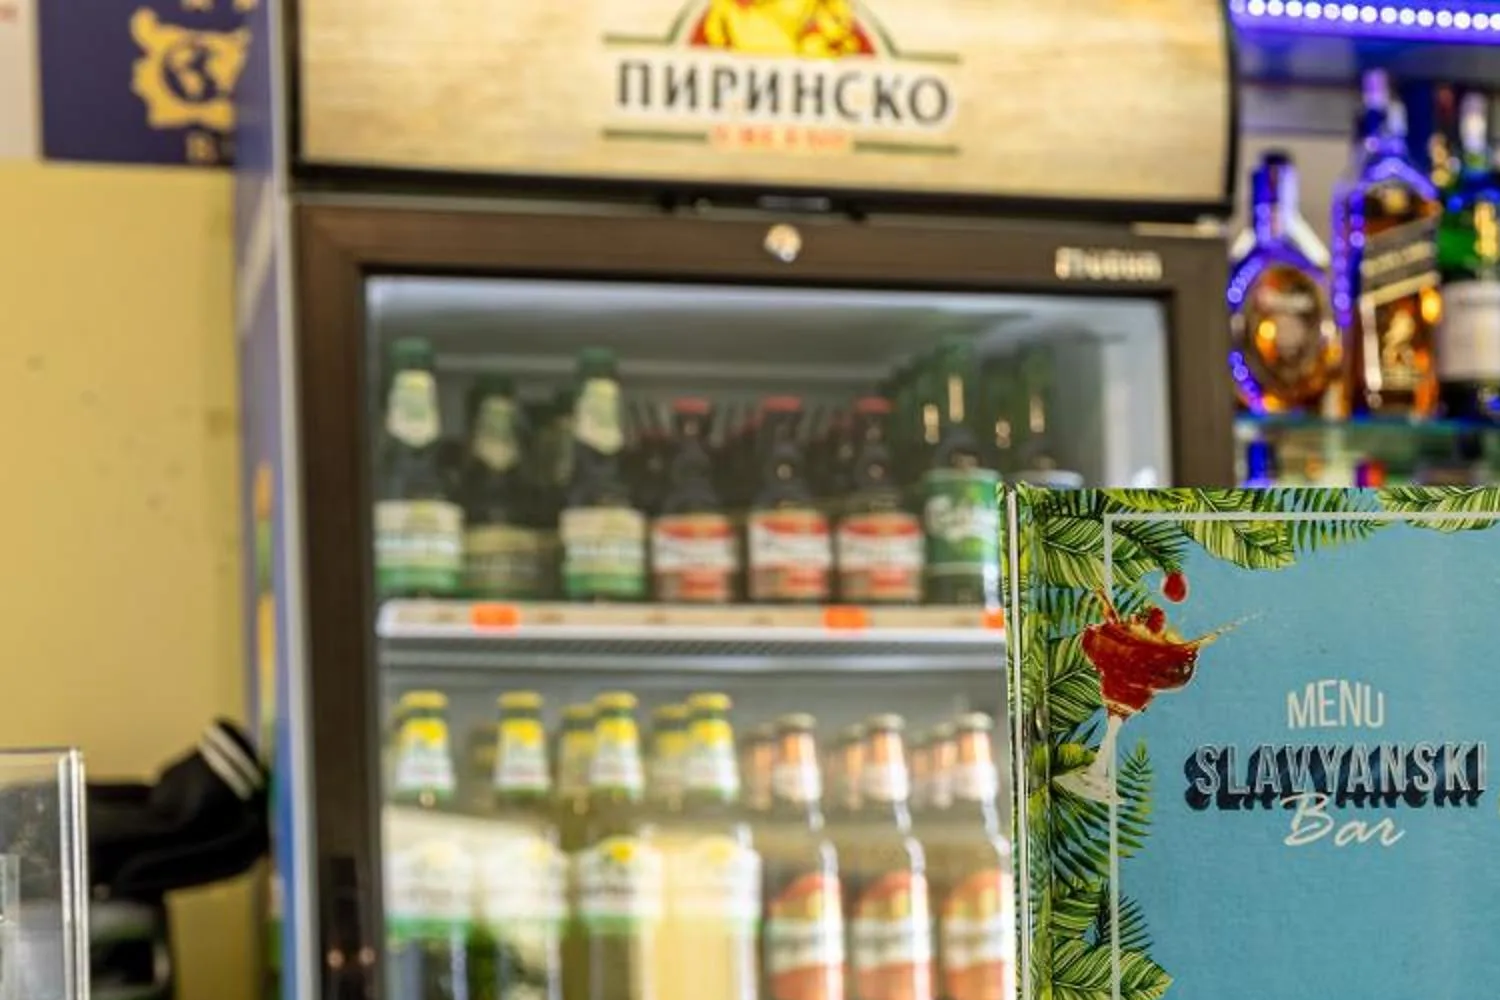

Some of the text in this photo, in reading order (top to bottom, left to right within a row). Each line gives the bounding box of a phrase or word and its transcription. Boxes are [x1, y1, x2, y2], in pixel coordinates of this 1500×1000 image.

[617, 58, 952, 125] ПИРИНСКО
[1286, 678, 1386, 730] MENU
[1185, 742, 1488, 808] SLAVYANSKI
[1280, 791, 1406, 847] Bar
